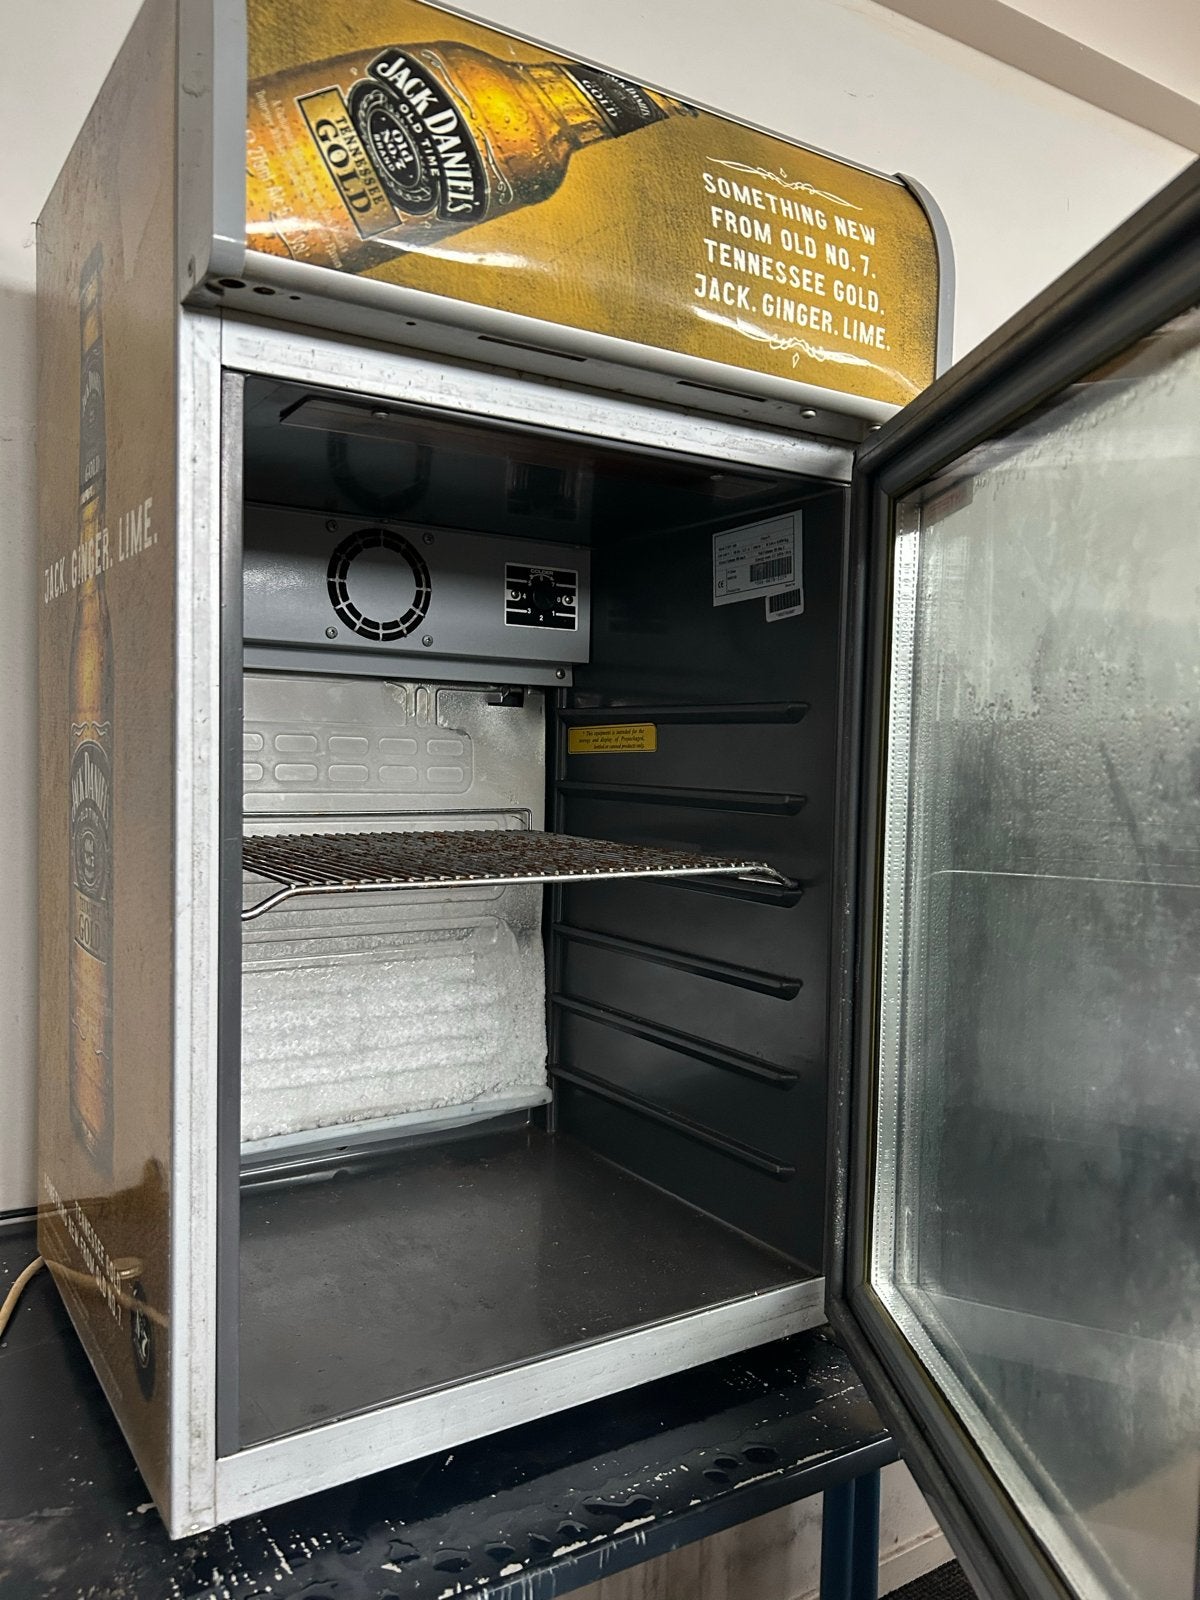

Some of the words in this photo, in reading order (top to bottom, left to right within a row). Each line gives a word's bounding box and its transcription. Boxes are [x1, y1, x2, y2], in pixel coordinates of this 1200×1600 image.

[315, 118, 372, 213] GOLD
[336, 115, 385, 205] TENNESSEE
[373, 133, 397, 172] BRAND
[376, 57, 438, 115] JACK
[424, 108, 481, 213] DANIEL'S
[400, 103, 423, 134] OLD
[421, 138, 441, 177] TIME
[702, 172, 828, 231] SOMETHING
[834, 215, 876, 246] NEW
[711, 205, 772, 246] FROM
[780, 228, 817, 259] OLD
[825, 242, 856, 272] NO.
[860, 255, 877, 279] 7.
[694, 273, 757, 312] JACK.
[762, 293, 839, 336] GINGER.
[843, 316, 891, 351] LIME.
[703, 238, 826, 297] TENNESSEE
[833, 279, 885, 315] GOLD.
[44, 556, 68, 604] JACK.
[72, 527, 113, 589] GINGER.
[119, 497, 158, 562] LIME.
